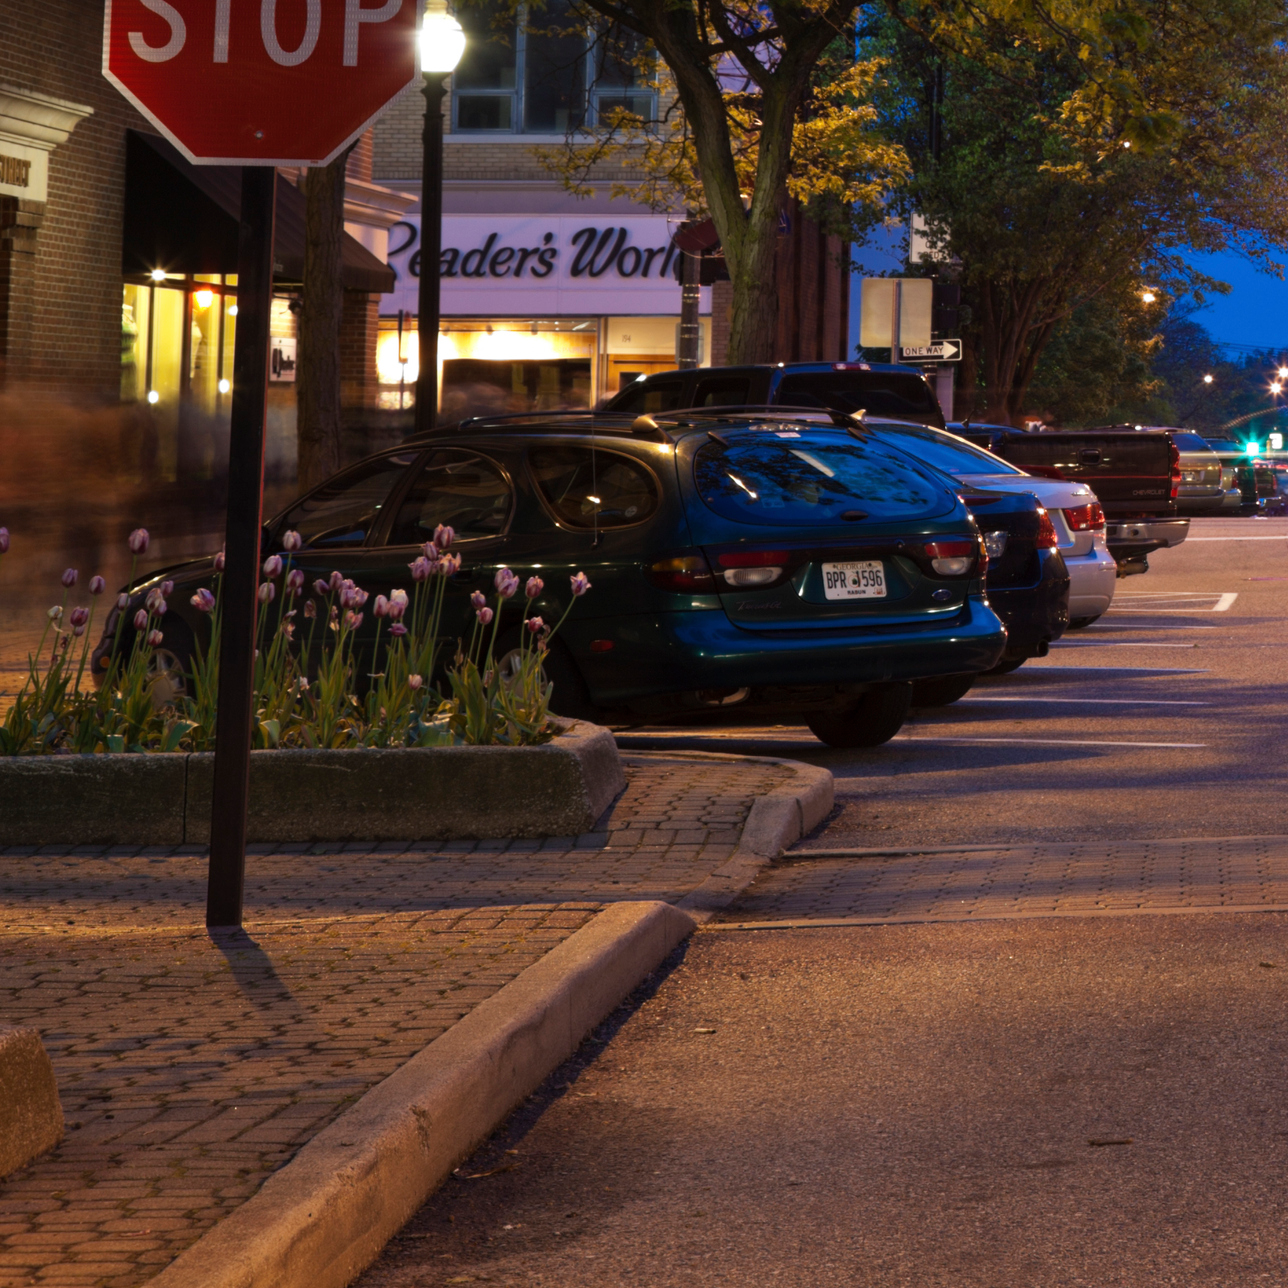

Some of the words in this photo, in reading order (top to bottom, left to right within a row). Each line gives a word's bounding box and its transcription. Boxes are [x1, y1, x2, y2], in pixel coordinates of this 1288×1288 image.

[569, 226, 681, 279] Worl
[904, 347, 924, 357] ONE
[925, 345, 944, 355] WAY
[1132, 488, 1166, 496] CHEVROLET
[835, 562, 869, 571] GEORGIA
[826, 571, 848, 589] BPR
[856, 569, 883, 588] 1596
